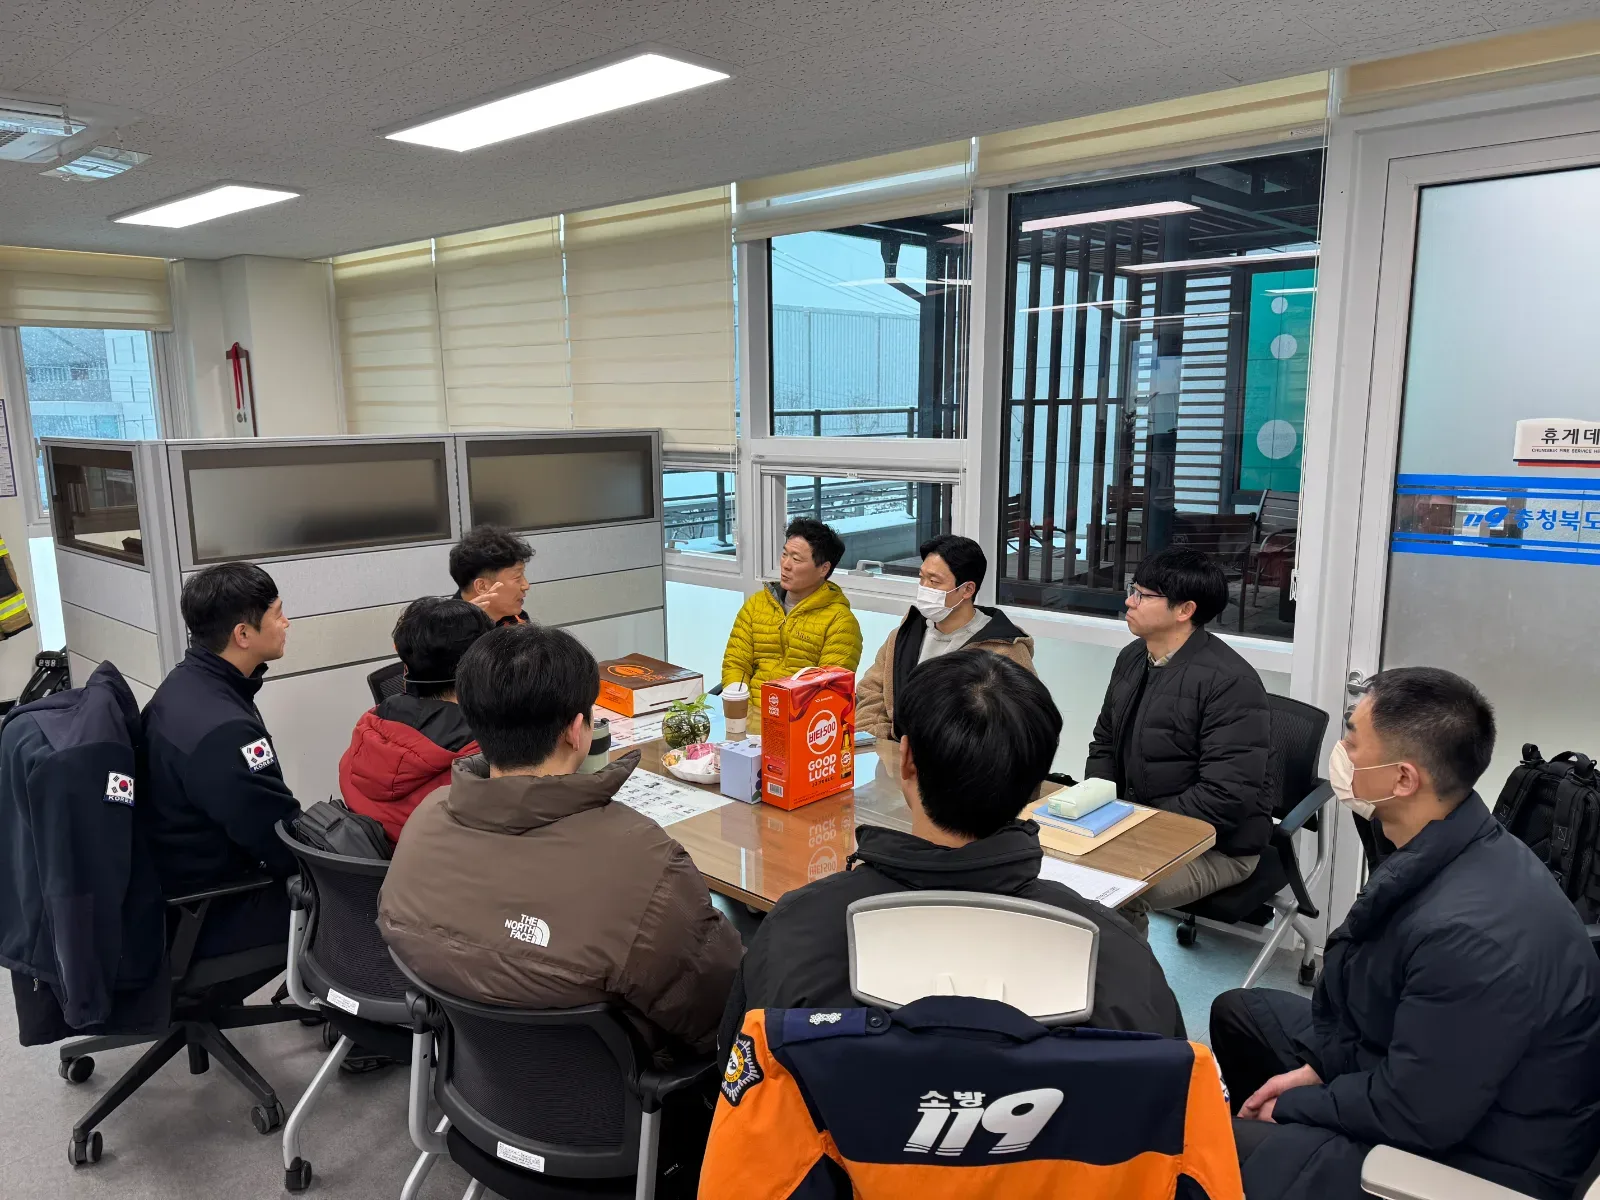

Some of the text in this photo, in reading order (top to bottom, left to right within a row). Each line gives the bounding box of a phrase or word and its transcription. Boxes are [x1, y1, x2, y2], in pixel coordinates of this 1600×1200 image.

[253, 758, 275, 771] KOREA
[808, 753, 837, 771] GOOD
[808, 764, 836, 783] LUCK
[108, 795, 133, 805] KOREA
[504, 919, 536, 935] NORTH
[520, 913, 538, 927] THE
[510, 929, 532, 943] FACE
[919, 1090, 986, 1108] 소방
[903, 1087, 1065, 1157] 119
